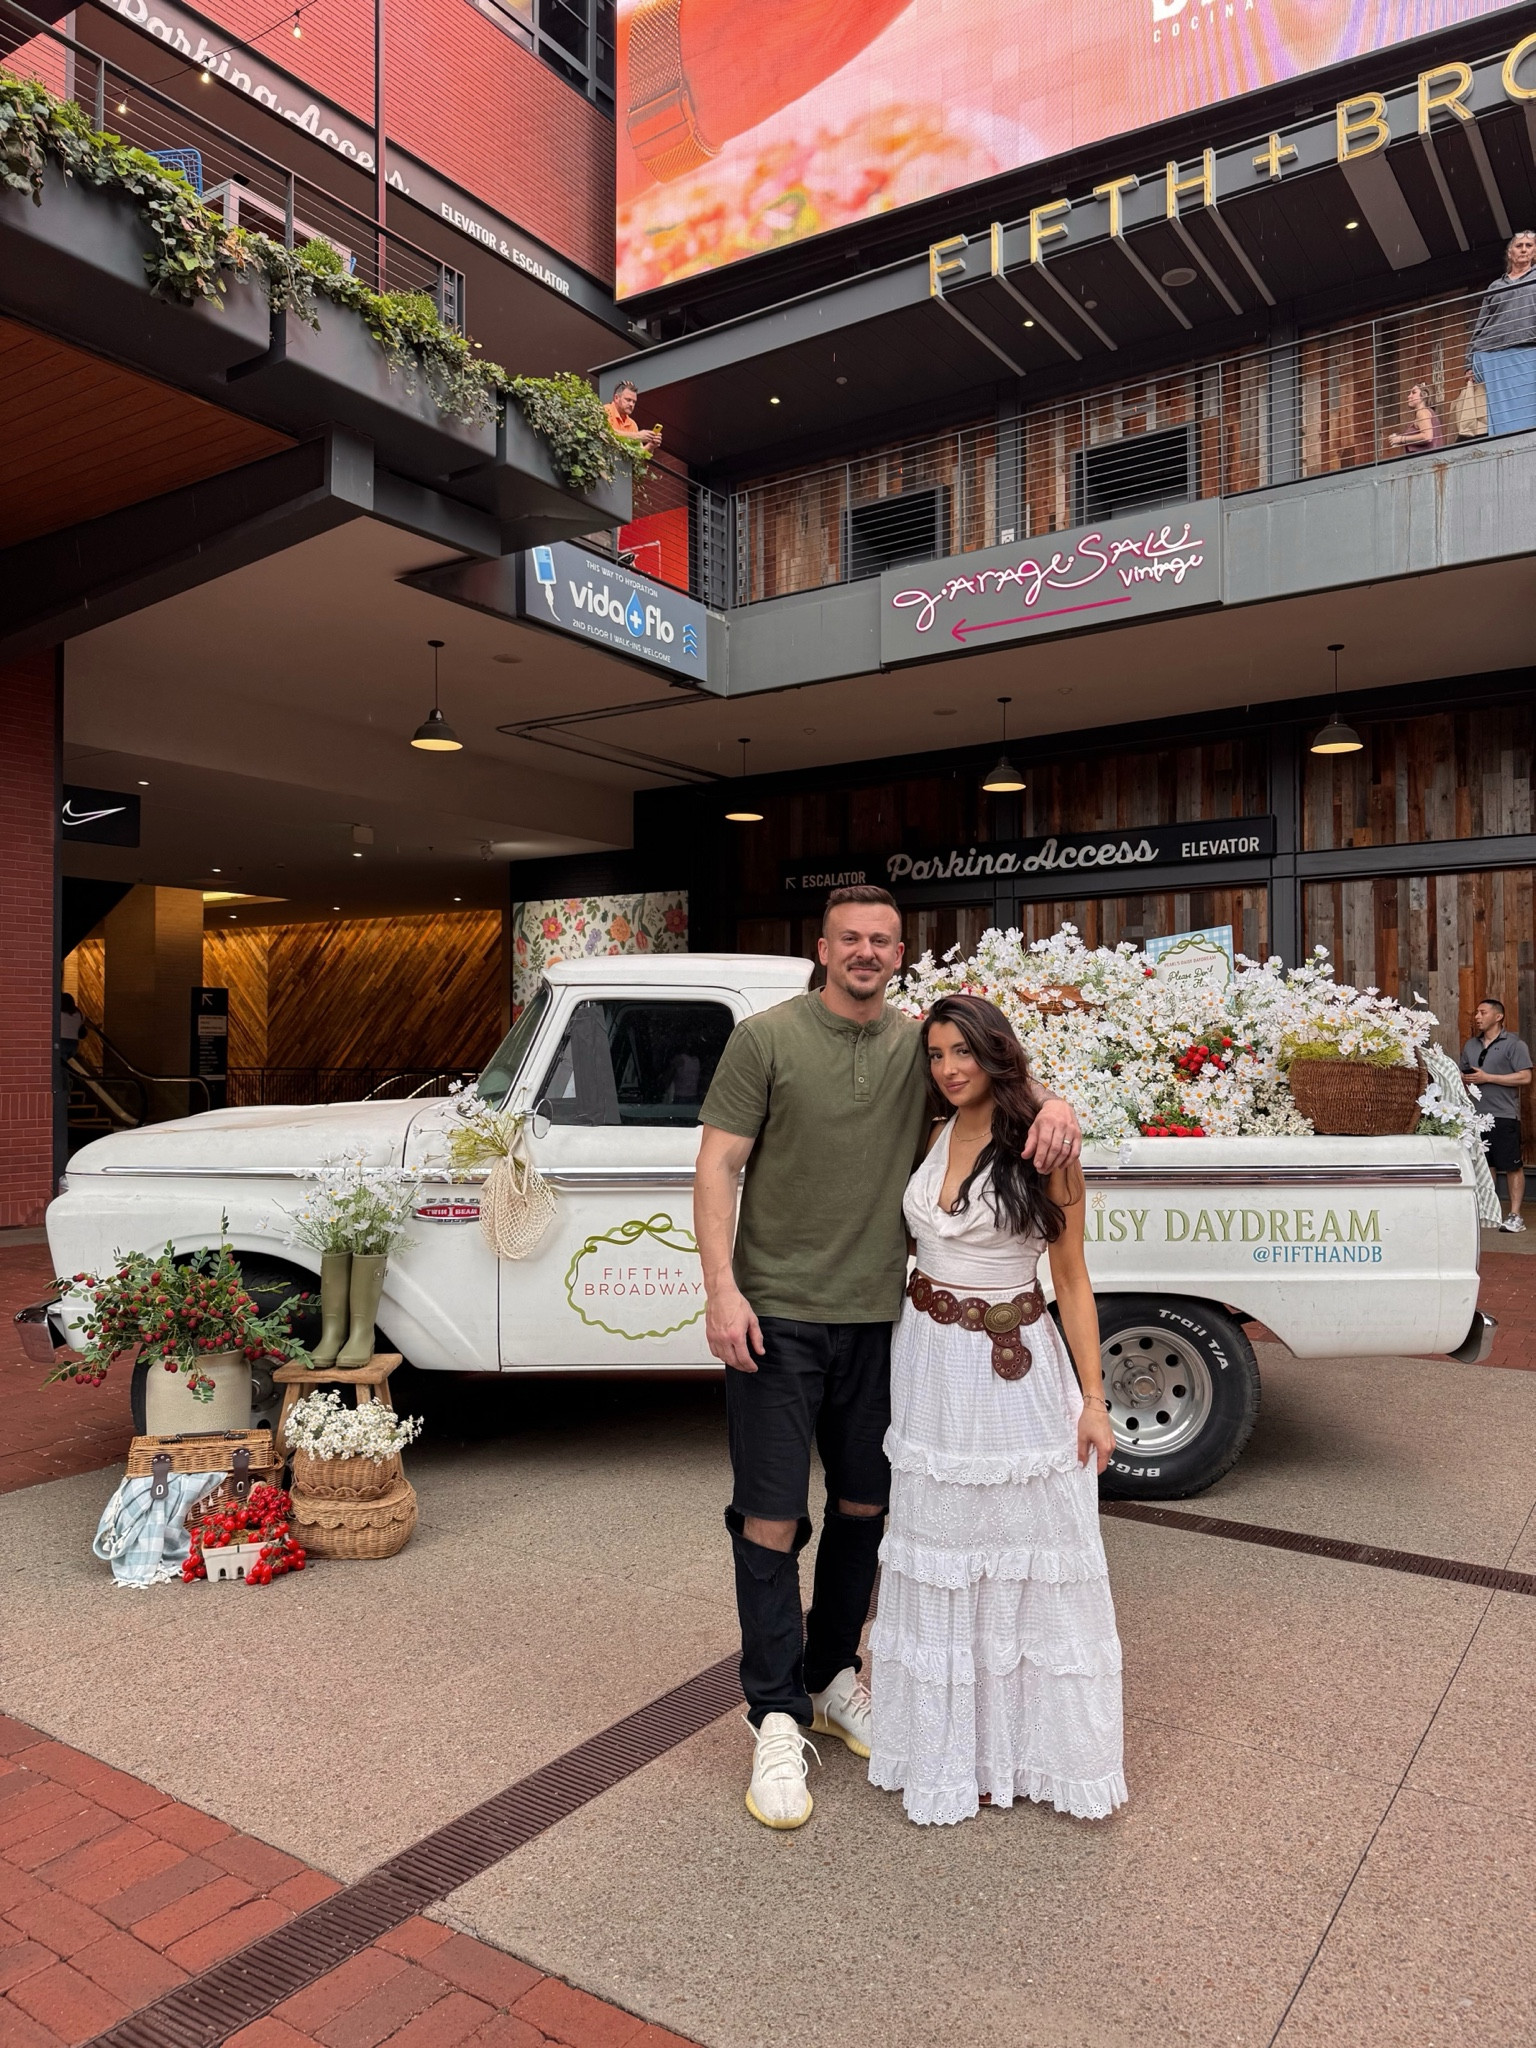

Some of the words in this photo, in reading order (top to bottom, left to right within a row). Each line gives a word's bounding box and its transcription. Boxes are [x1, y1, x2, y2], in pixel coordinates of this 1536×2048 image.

[1153, 0, 1254, 43] COCINA
[929, 148, 1216, 297] FIFTH
[441, 202, 497, 250] ELEVATOR
[500, 240, 510, 258] &
[512, 248, 570, 297] ESCALATOR
[586, 560, 600, 573] THIS
[601, 567, 614, 578] WAY
[615, 573, 624, 583] TO
[625, 577, 659, 598] HYDRATION
[572, 618, 586, 630] 2ND
[587, 624, 609, 639] FLOOR
[613, 634, 641, 651] WALK-INS
[642, 646, 671, 663] WELCOME
[802, 871, 866, 888] ESCALATOR
[1022, 838, 1159, 872] Access
[1181, 836, 1260, 858] ELEVATOR
[1167, 970, 1192, 983] Please
[1165, 1208, 1383, 1243] DAYDREAM
[1252, 1245, 1383, 1264] @FIFTHANDB
[583, 1282, 703, 1297] BROADWAY
[1158, 1308, 1207, 1337] Trail
[1208, 1338, 1229, 1370] T/A
